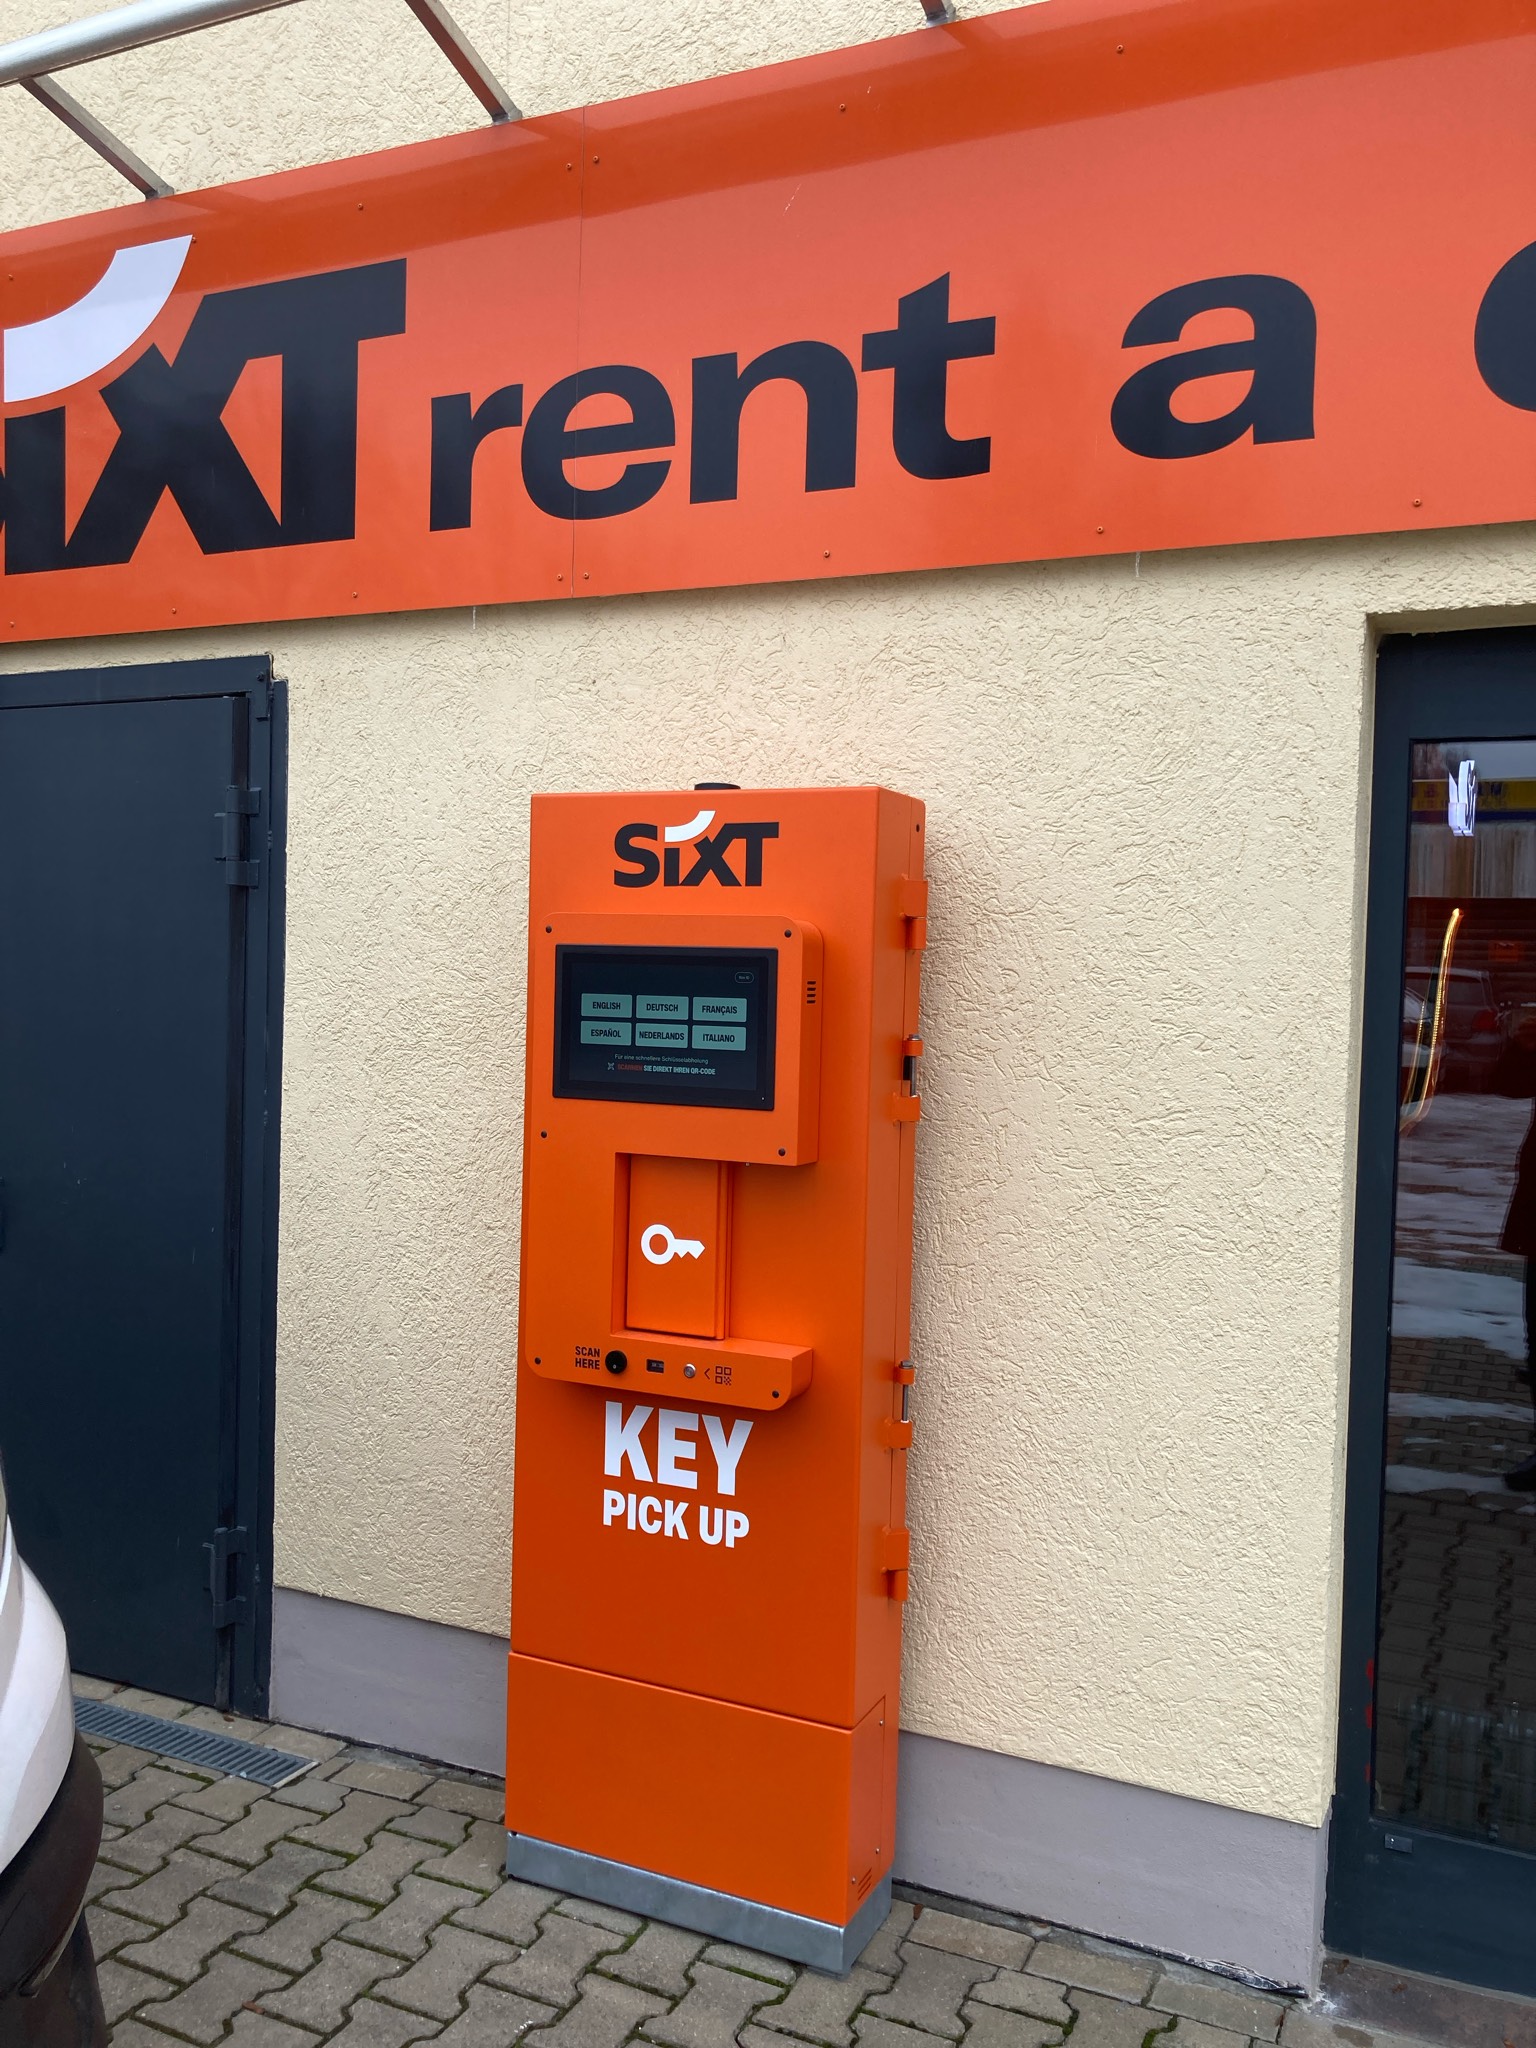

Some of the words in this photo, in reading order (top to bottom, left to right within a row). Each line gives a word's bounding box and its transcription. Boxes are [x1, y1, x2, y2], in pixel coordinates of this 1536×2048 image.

[430, 271, 996, 520] rent
[1110, 273, 1317, 460] a
[592, 1001, 621, 1011] ENGLISH
[646, 1003, 679, 1013] DEUTSCH
[701, 1004, 738, 1016] FRANÇAIS
[590, 1028, 622, 1039] ESPAÑOL
[639, 1030, 685, 1042] NEDERLANDS
[702, 1033, 735, 1043] ITALIANO
[643, 1064, 652, 1072] SIE
[652, 1065, 673, 1073] DIREKT
[690, 1067, 716, 1075] QR-CODE
[575, 1345, 600, 1358] SCAN
[575, 1357, 600, 1370] HERE
[604, 1400, 754, 1497] KEY
[603, 1488, 689, 1541] PICK
[699, 1505, 750, 1549] UP
